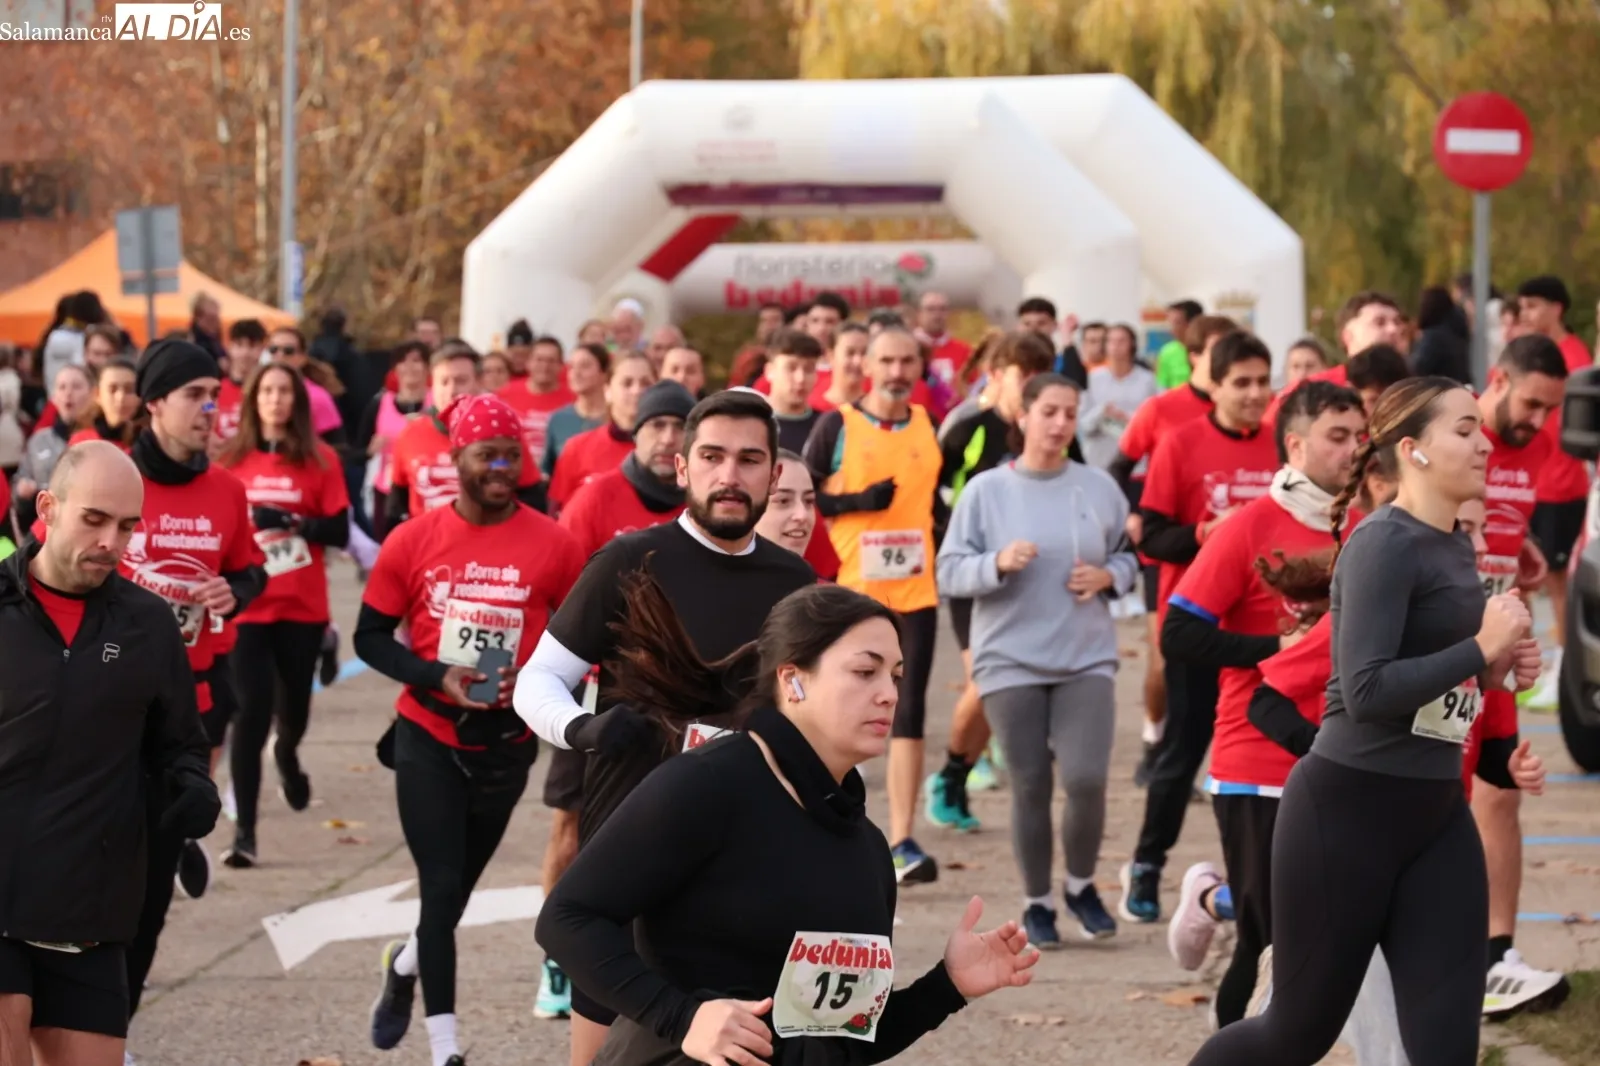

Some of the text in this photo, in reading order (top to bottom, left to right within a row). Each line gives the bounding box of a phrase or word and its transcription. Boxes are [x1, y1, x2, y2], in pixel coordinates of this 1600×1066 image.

[882, 548, 906, 567] 96
[448, 604, 521, 629] bedunia
[788, 937, 892, 970] bedunia
[812, 971, 859, 1010] 15
